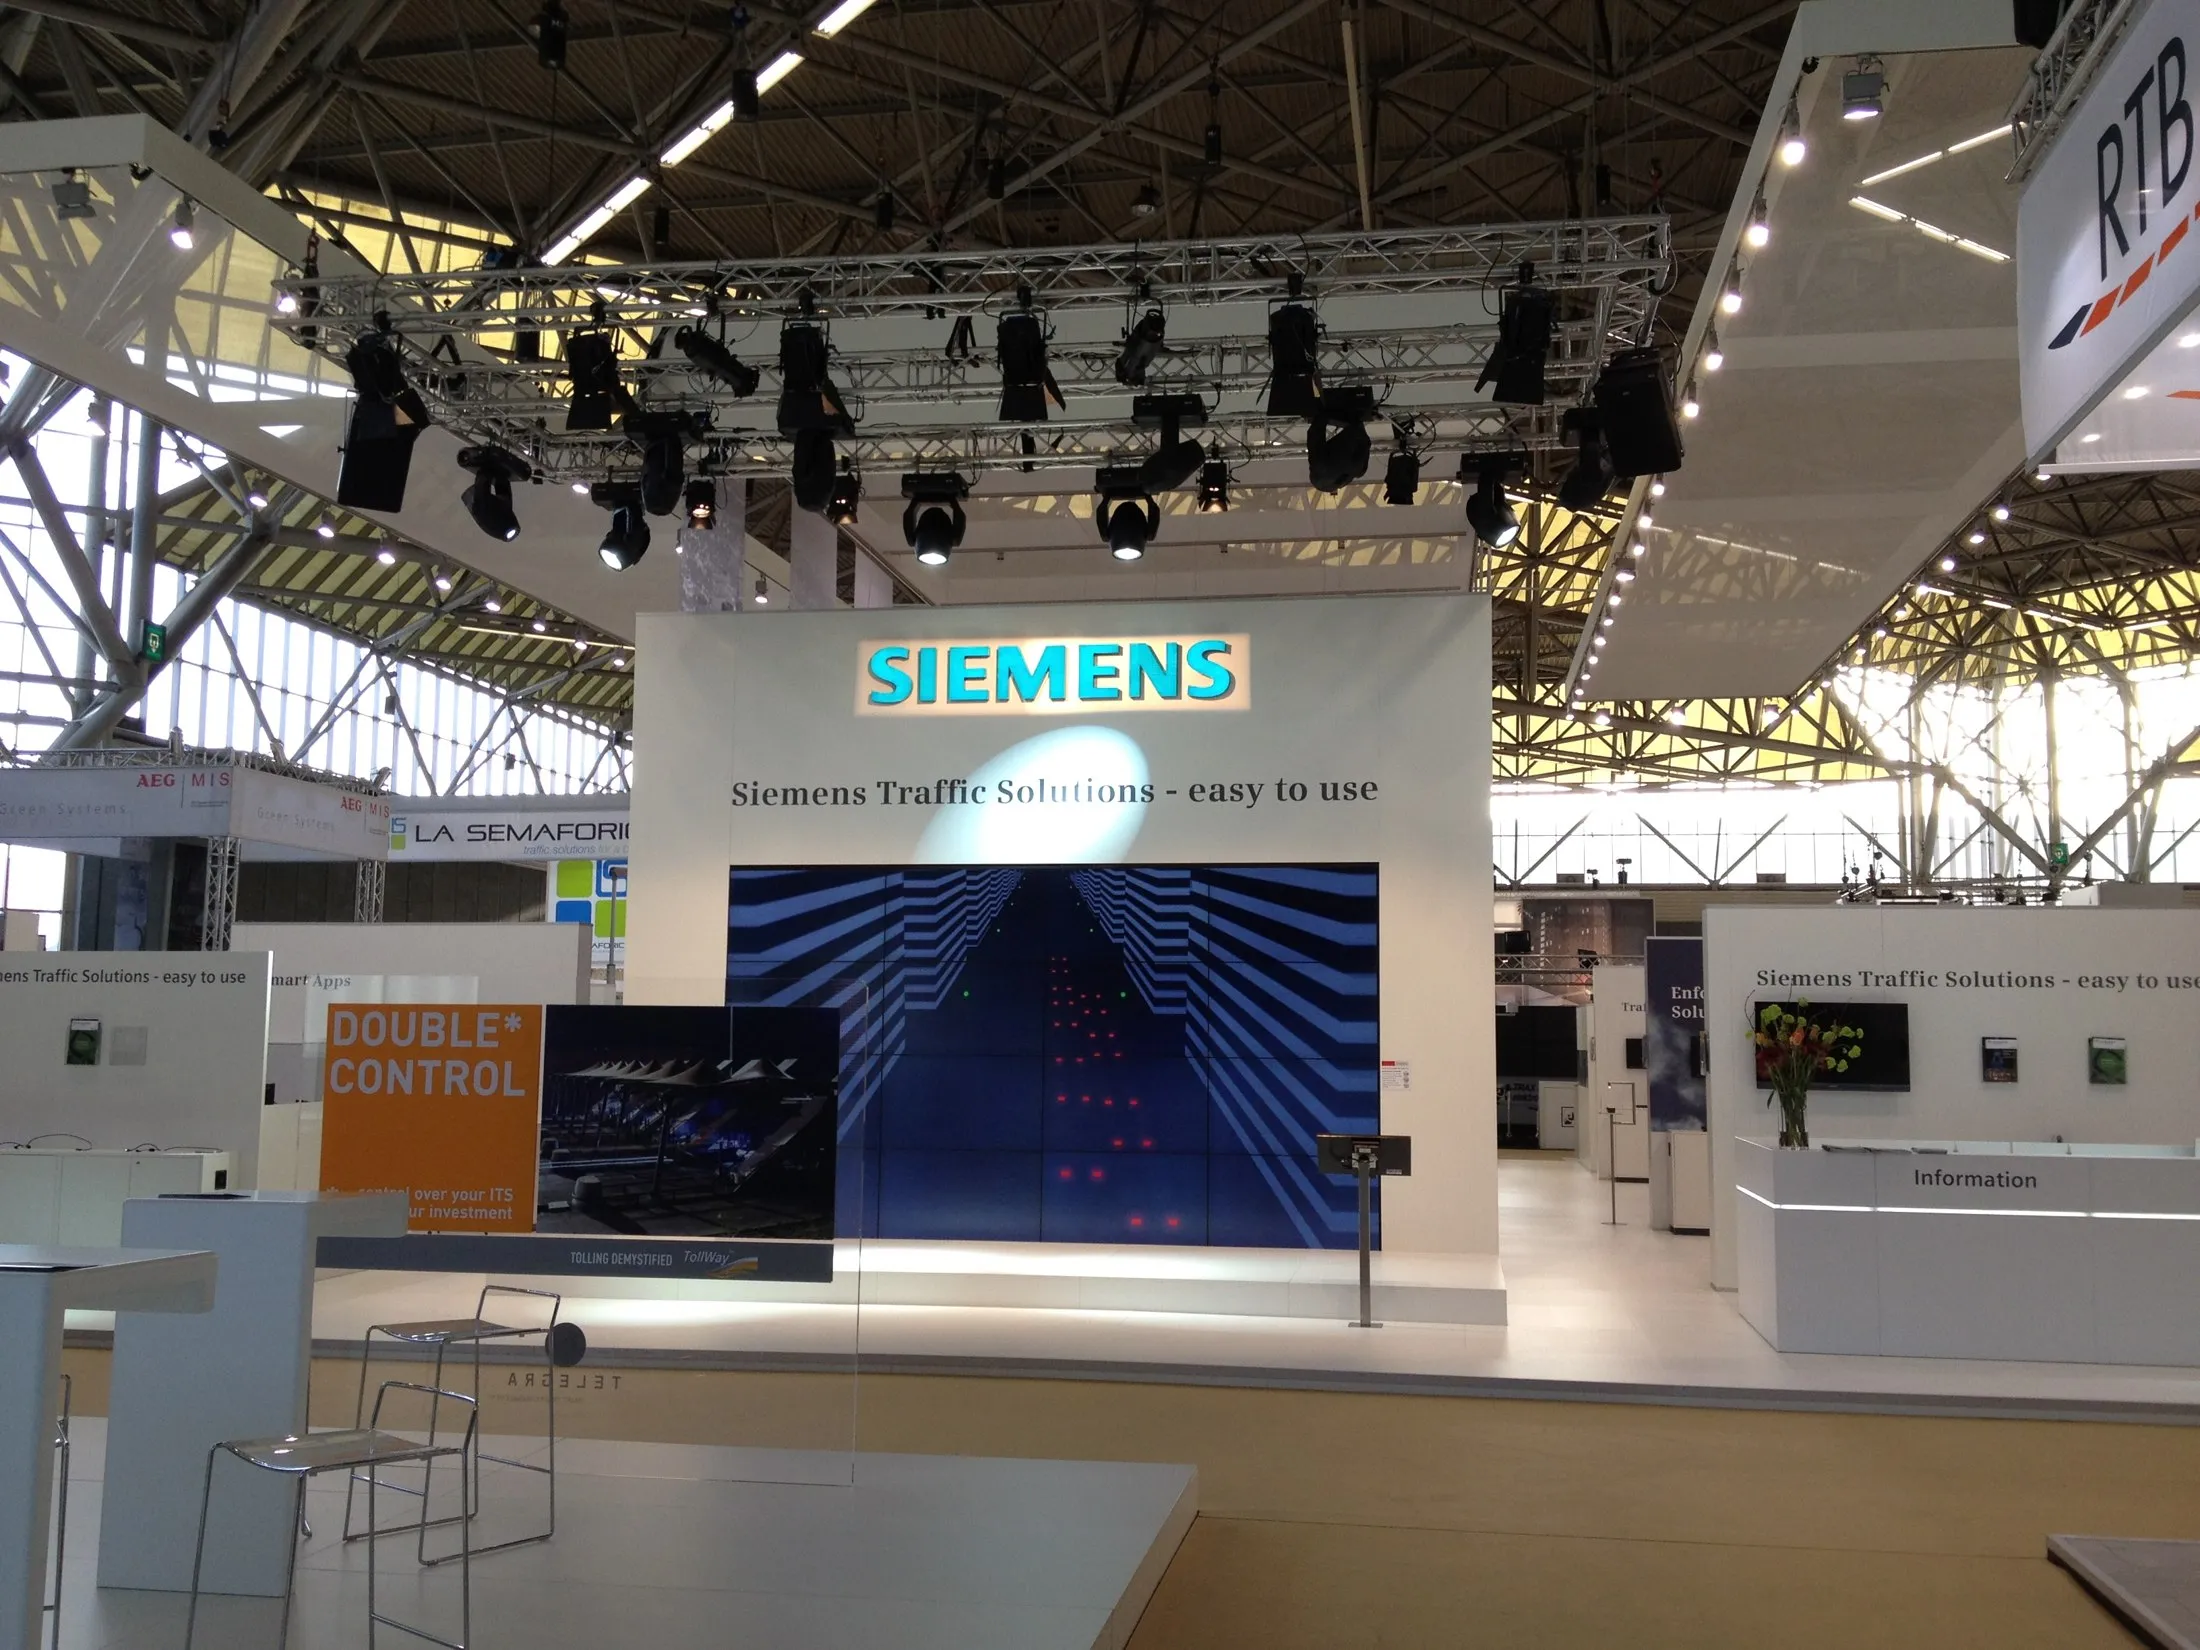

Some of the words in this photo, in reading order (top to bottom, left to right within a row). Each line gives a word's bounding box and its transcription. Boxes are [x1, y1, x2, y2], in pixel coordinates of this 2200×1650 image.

[2096, 36, 2194, 282] RTB
[867, 640, 1237, 705] SIEMENS
[136, 773, 175, 787] AEG
[732, 781, 866, 807] Siemens
[877, 778, 986, 805] Traffic
[998, 777, 1155, 804] Solutions
[1189, 782, 1264, 809] easy
[1275, 777, 1308, 802] to
[1320, 780, 1378, 801] use
[340, 796, 362, 812] AEG
[415, 824, 454, 842] LA
[523, 844, 549, 855] traffic
[553, 843, 596, 855] solutions
[33, 968, 78, 983] Traffic
[82, 969, 150, 983] Solutions
[163, 972, 196, 987] easy
[201, 971, 216, 984] to
[220, 972, 246, 984] use
[312, 975, 351, 990] Apps
[1757, 970, 1851, 987] Siemens
[1858, 970, 1938, 988] Traffic
[1945, 970, 2055, 988] Solutions
[2078, 975, 2129, 993] easy
[2136, 973, 2158, 989] to
[330, 1058, 526, 1097] CONTROL
[1914, 1168, 2038, 1188] Information
[415, 1189, 447, 1201] over
[451, 1189, 486, 1203] your
[490, 1188, 514, 1202] ITS
[429, 1204, 513, 1220] investment
[570, 1252, 608, 1264] TOLLING
[612, 1252, 673, 1267] DEMYSTIFIED
[683, 1250, 730, 1266] TollWay
